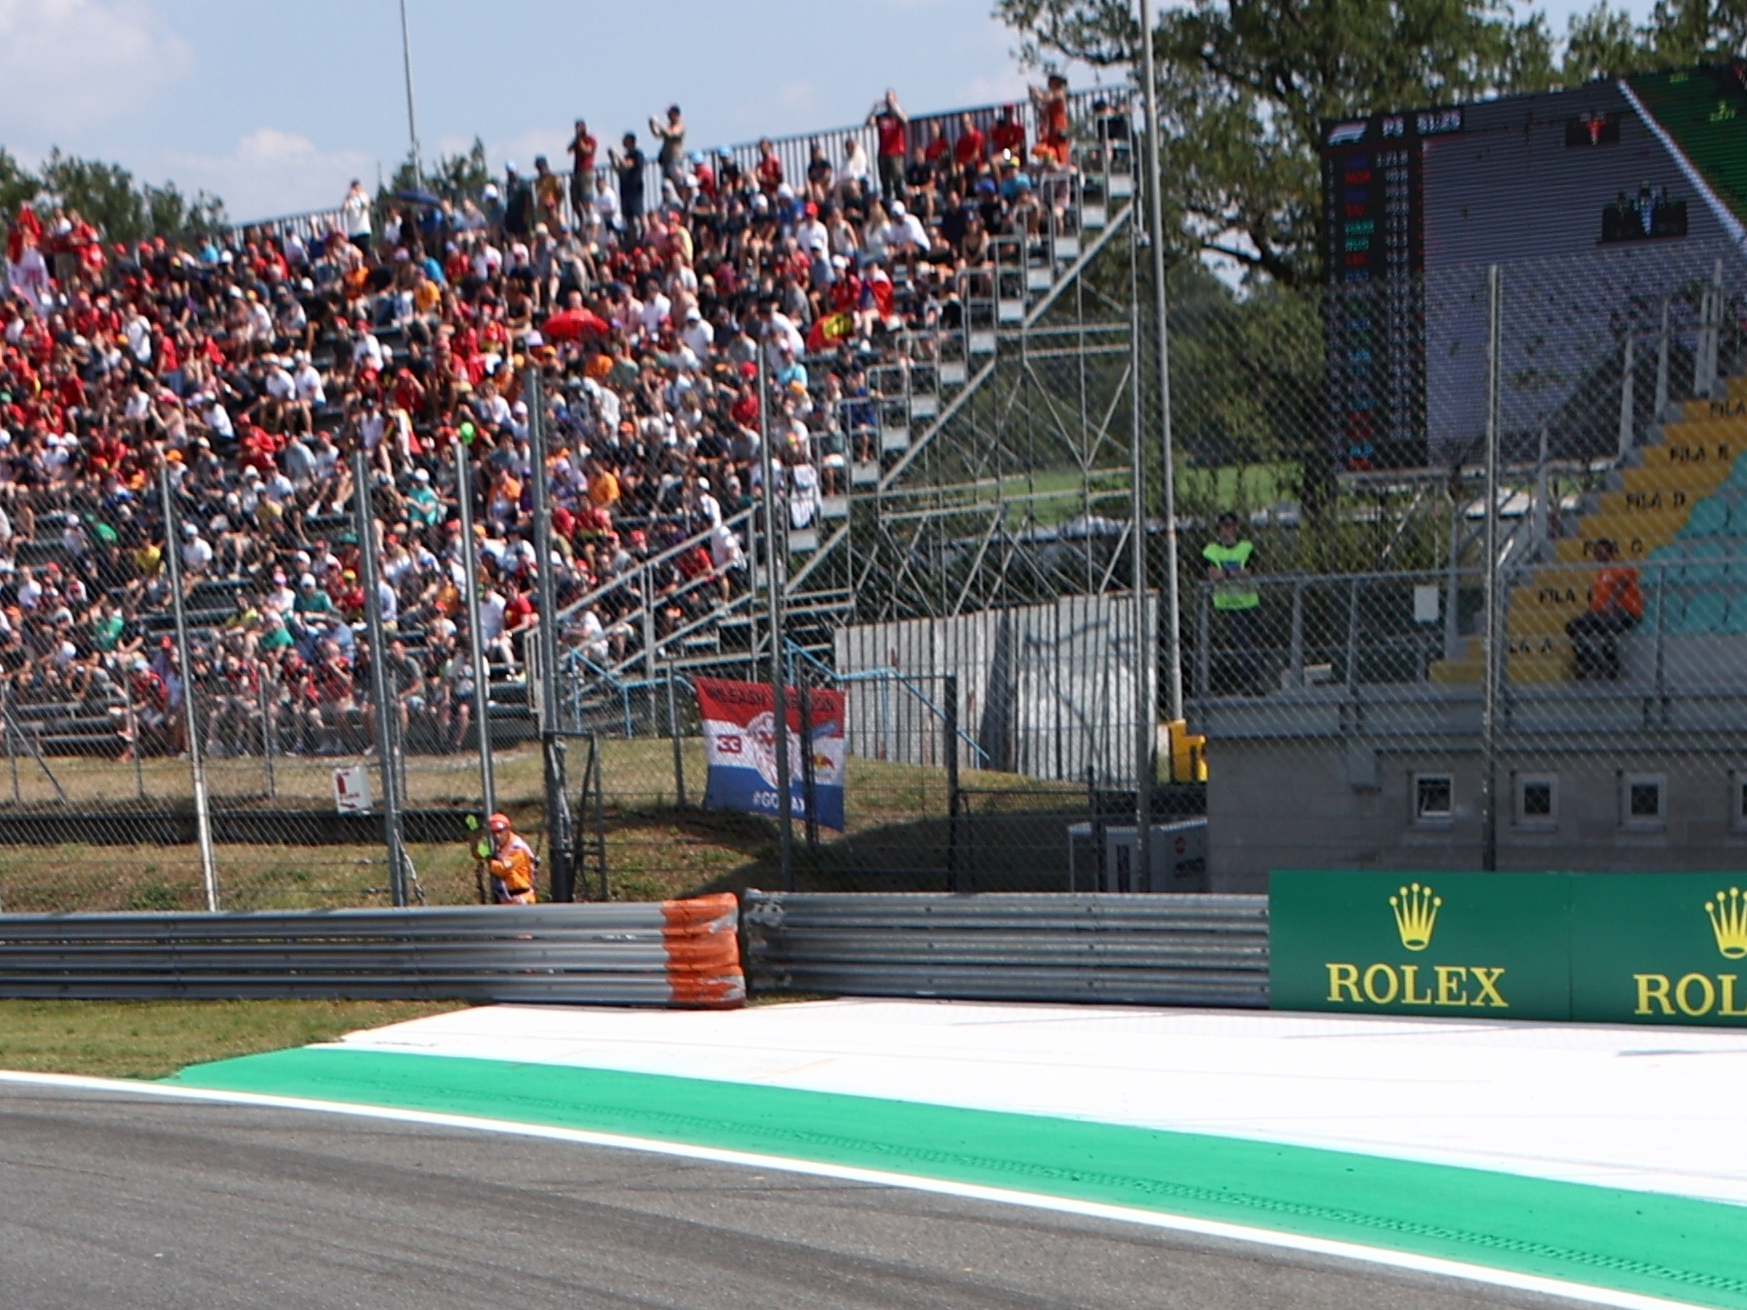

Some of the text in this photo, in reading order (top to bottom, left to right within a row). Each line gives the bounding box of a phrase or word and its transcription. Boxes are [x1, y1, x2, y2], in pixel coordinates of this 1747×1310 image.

[1670, 445, 1706, 463] FILA
[1626, 491, 1663, 509] FILA
[1325, 962, 1509, 1008] ROLEX
[1633, 972, 1747, 1016] ROL
